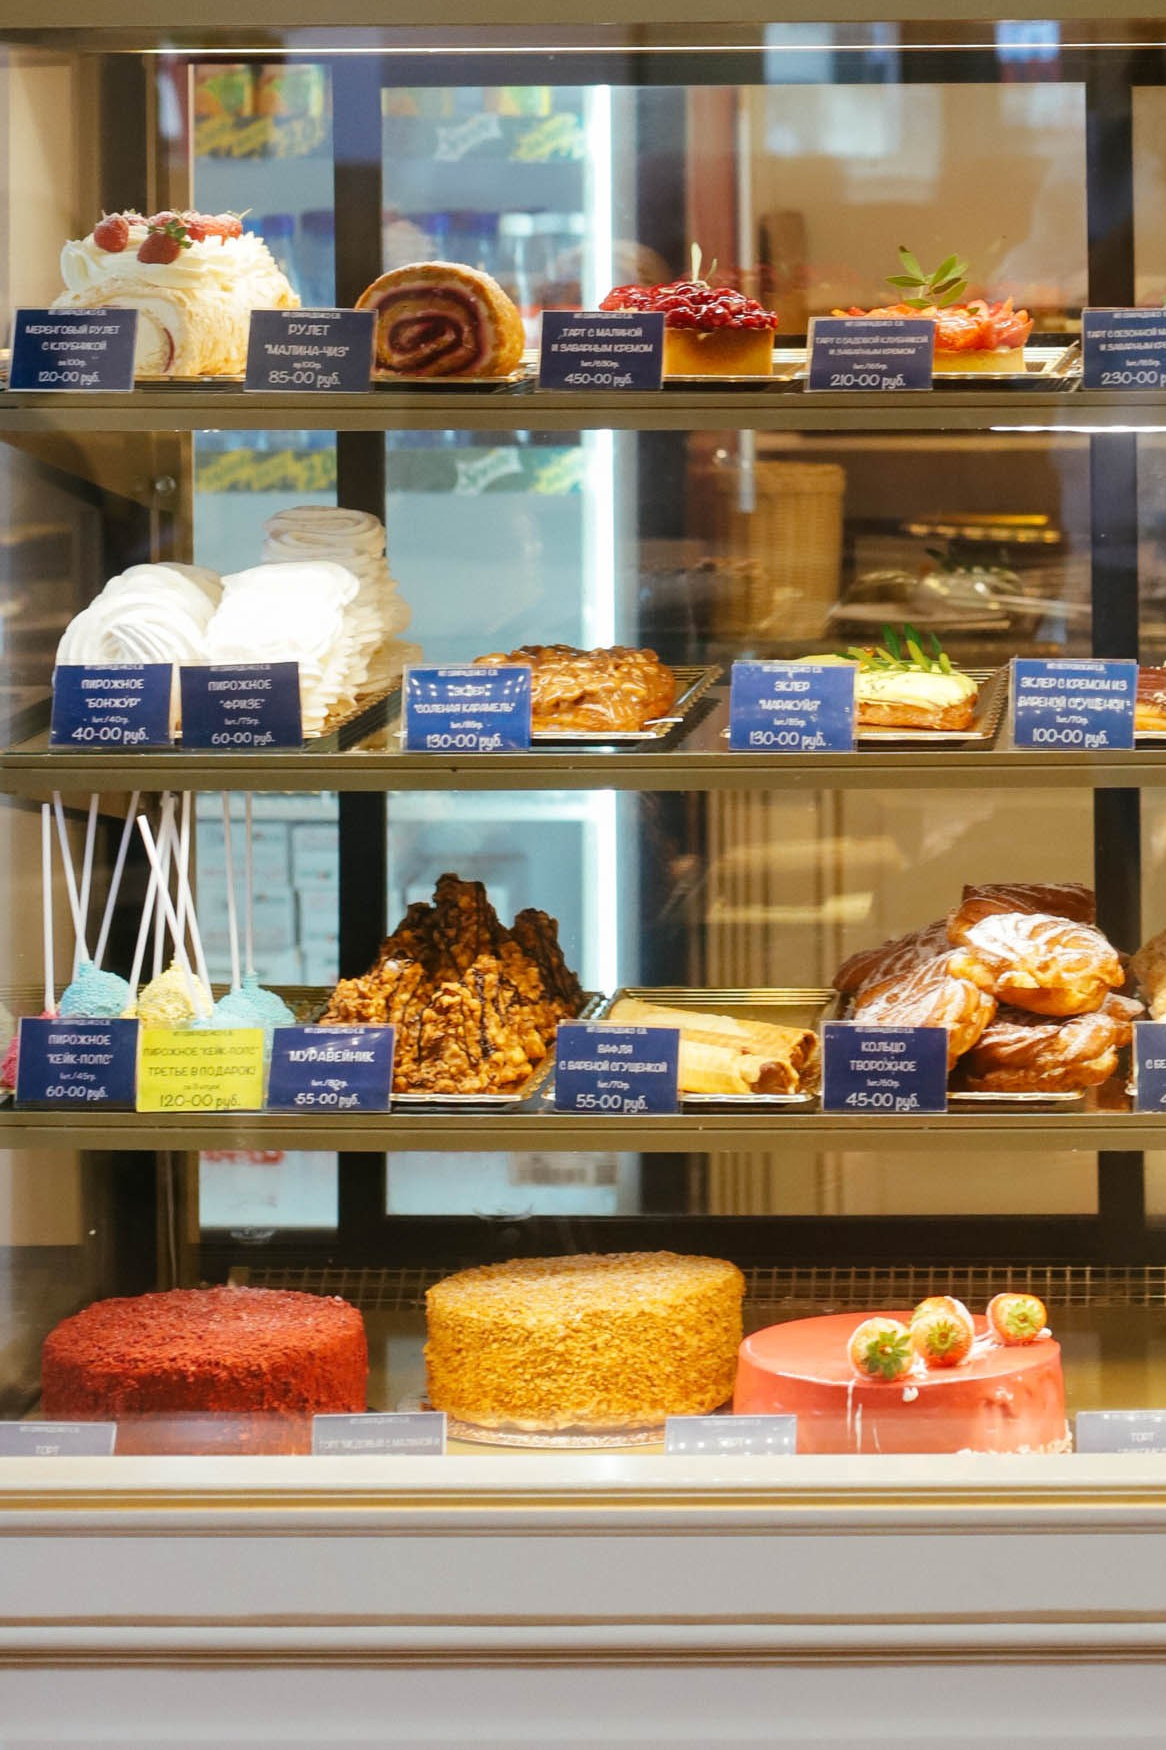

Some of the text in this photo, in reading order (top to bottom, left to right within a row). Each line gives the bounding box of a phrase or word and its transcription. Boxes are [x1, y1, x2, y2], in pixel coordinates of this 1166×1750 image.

[287, 324, 330, 336] РУЛЕТ
[268, 371, 315, 384] 85-00
[564, 373, 612, 385] 450-00
[830, 373, 907, 390] 210-00 руб.
[1101, 371, 1158, 385] 230-00
[81, 678, 145, 690] ПИРОЖНОЕ
[208, 679, 272, 691] ПИРОЖНОЕ
[774, 681, 811, 692] ЭКЛЕР
[72, 727, 150, 745] 40-00 руб.
[211, 732, 252, 744] 60-00
[426, 734, 477, 748] 130-00
[750, 731, 799, 745] 130-00
[1032, 728, 1083, 743] 100-00
[48, 1034, 111, 1046] ПИРОЖНОЕ
[148, 1066, 188, 1077] ТРЕТЬЕ
[190, 1066, 198, 1076] В
[849, 1059, 917, 1072] ТВОРОЖНОЕ
[46, 1085, 87, 1098] 60-00
[159, 1094, 213, 1108] 120-00
[575, 1094, 648, 1113] 55-00 руб.
[845, 1092, 920, 1112] 45-00 руб.
